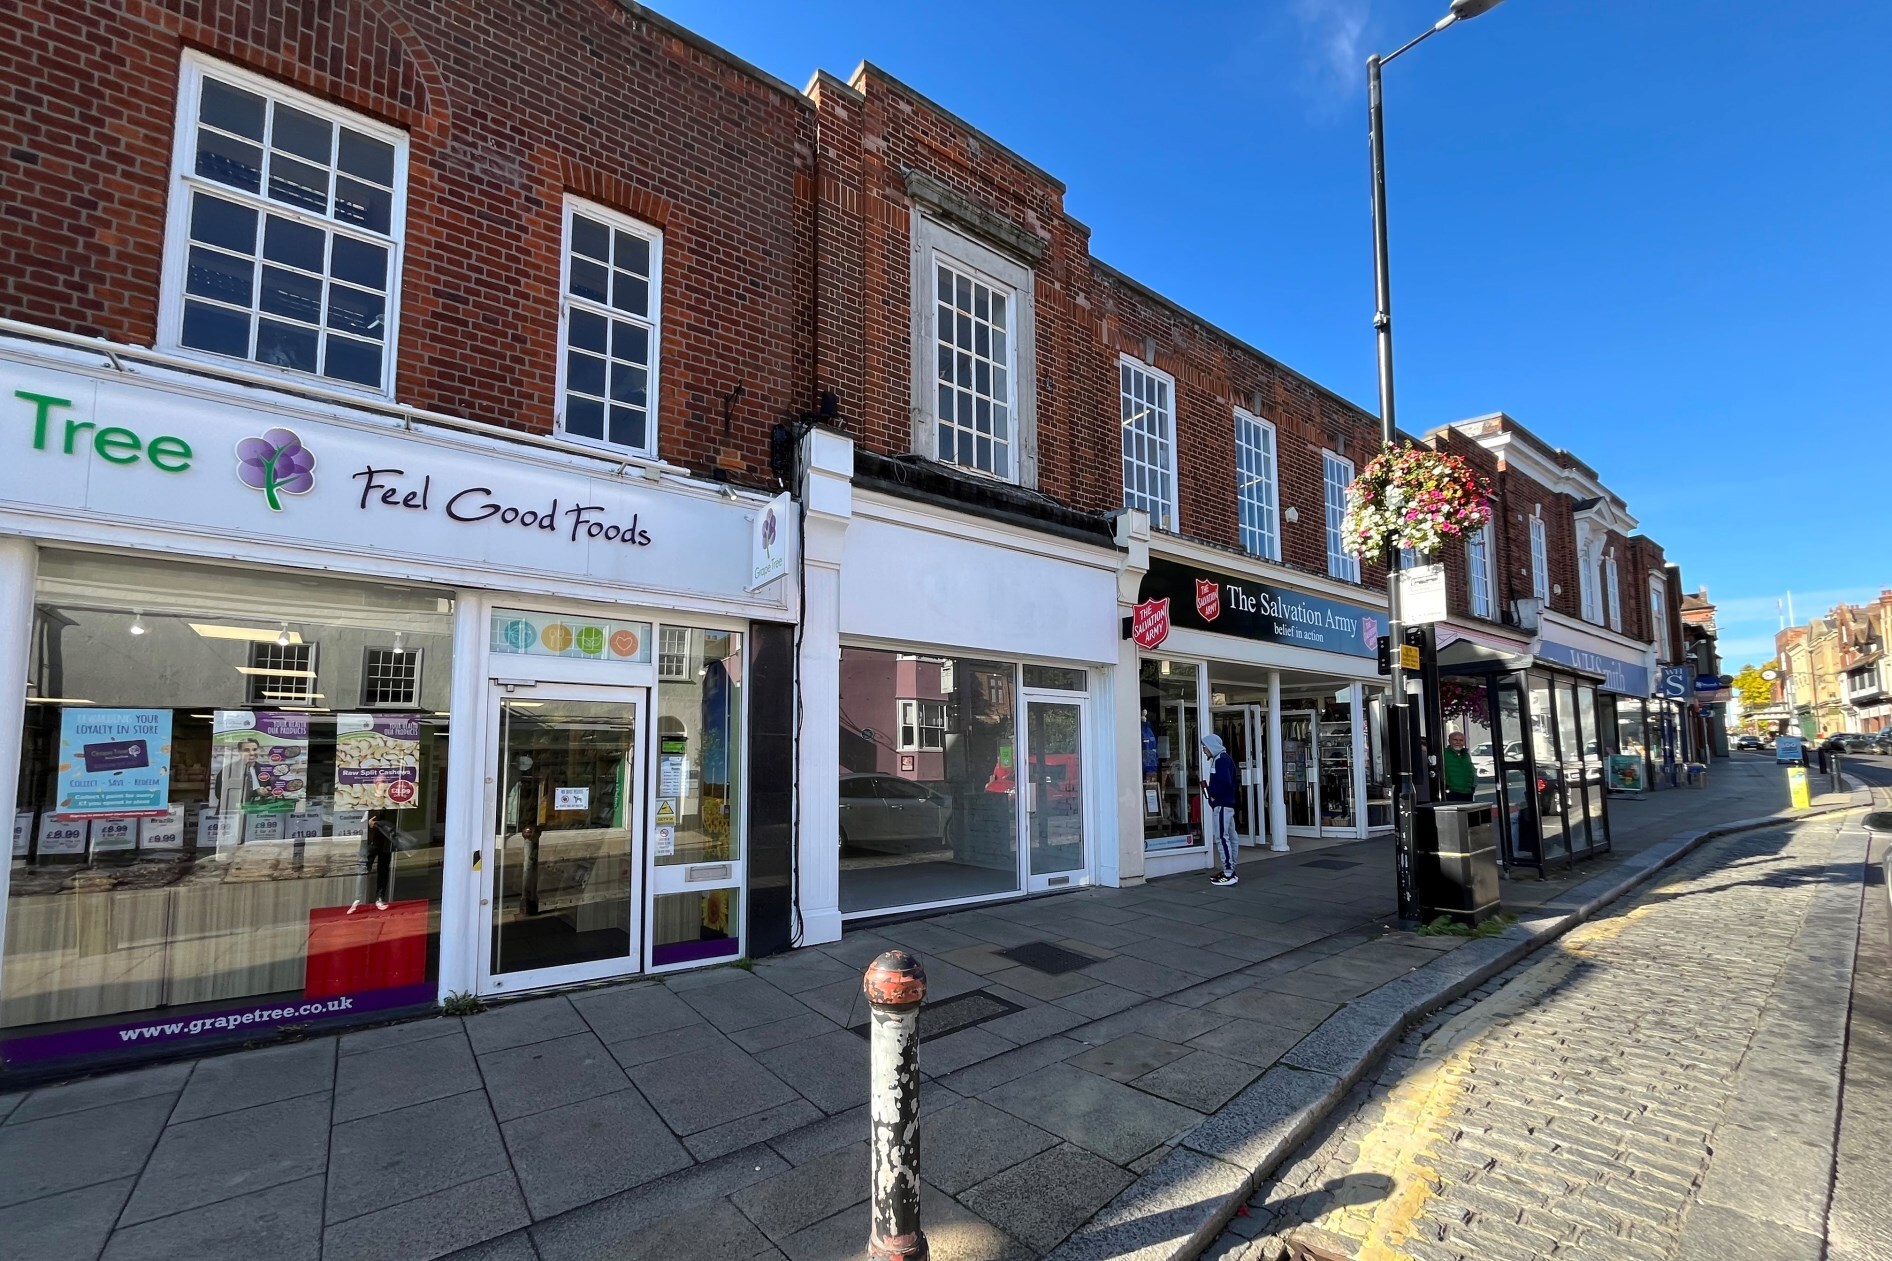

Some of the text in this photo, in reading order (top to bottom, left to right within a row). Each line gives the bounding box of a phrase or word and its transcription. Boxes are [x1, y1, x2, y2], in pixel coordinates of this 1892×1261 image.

[14, 389, 193, 472] Tree
[352, 465, 652, 547] Feel Good Foods
[754, 557, 783, 580] Grape Tree
[1201, 584, 1209, 595] THE
[1197, 591, 1218, 608] SALVATION
[1205, 601, 1217, 616] ARMY
[1140, 604, 1153, 620] THE
[1226, 584, 1256, 613] The
[1260, 593, 1322, 627] Salvation
[1325, 608, 1357, 638] Army
[1134, 605, 1165, 638] SALVATION
[1145, 621, 1163, 644] ARMY
[1274, 622, 1324, 642] belief in action
[1664, 667, 1683, 675] WH
[1666, 674, 1685, 695] S
[135, 714, 159, 723] YOUR
[76, 725, 159, 735] LOYALTY IN STORE
[280, 726, 307, 735] PRODUCTS
[70, 777, 160, 788] COLLECT SAVE REDEEM
[119, 996, 353, 1042] www.grapetree.co.uk
